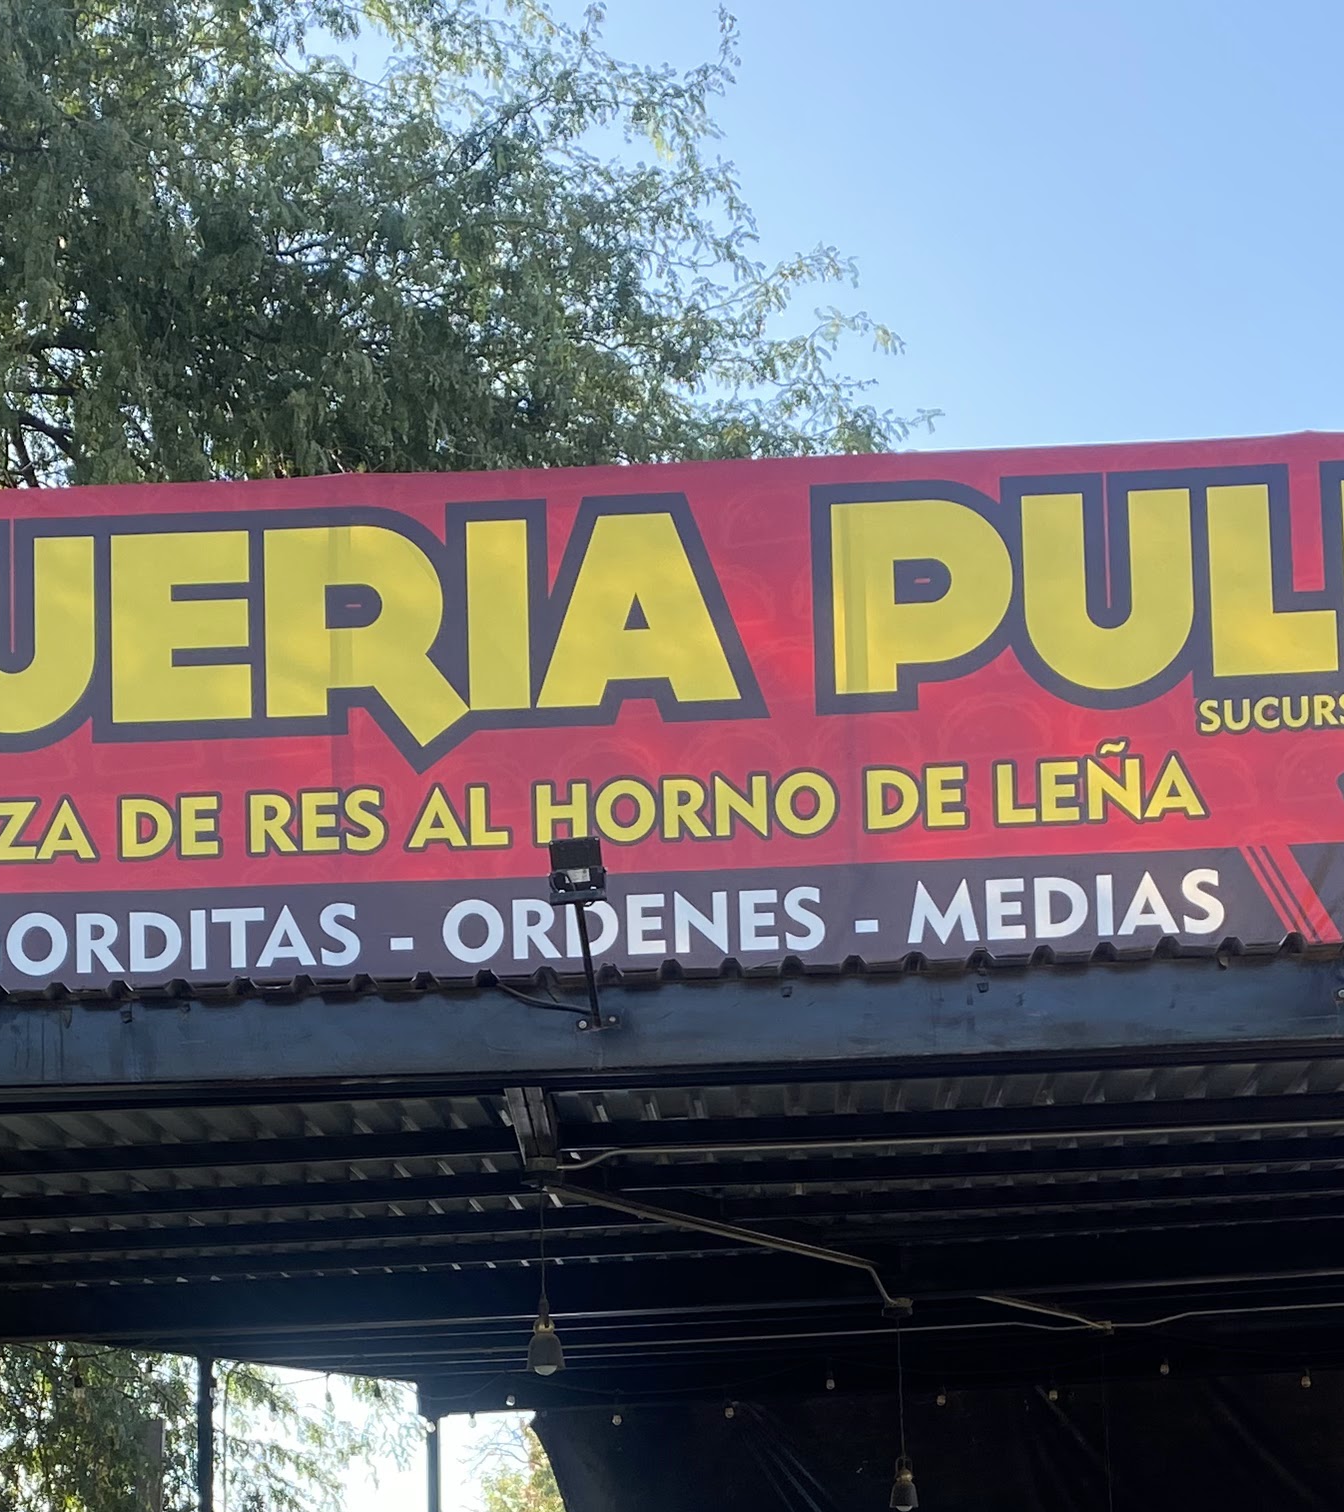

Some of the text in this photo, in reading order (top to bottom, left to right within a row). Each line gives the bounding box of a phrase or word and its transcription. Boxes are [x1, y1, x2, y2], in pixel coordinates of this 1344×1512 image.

[120, 795, 216, 859] DE
[248, 788, 386, 855] RES
[409, 785, 509, 849] AL
[534, 770, 837, 846] HORNO
[865, 766, 967, 831] DE
[995, 743, 1206, 825] LEÑA
[441, 885, 827, 964] ORDENES
[906, 868, 1226, 946] MEDIAS
